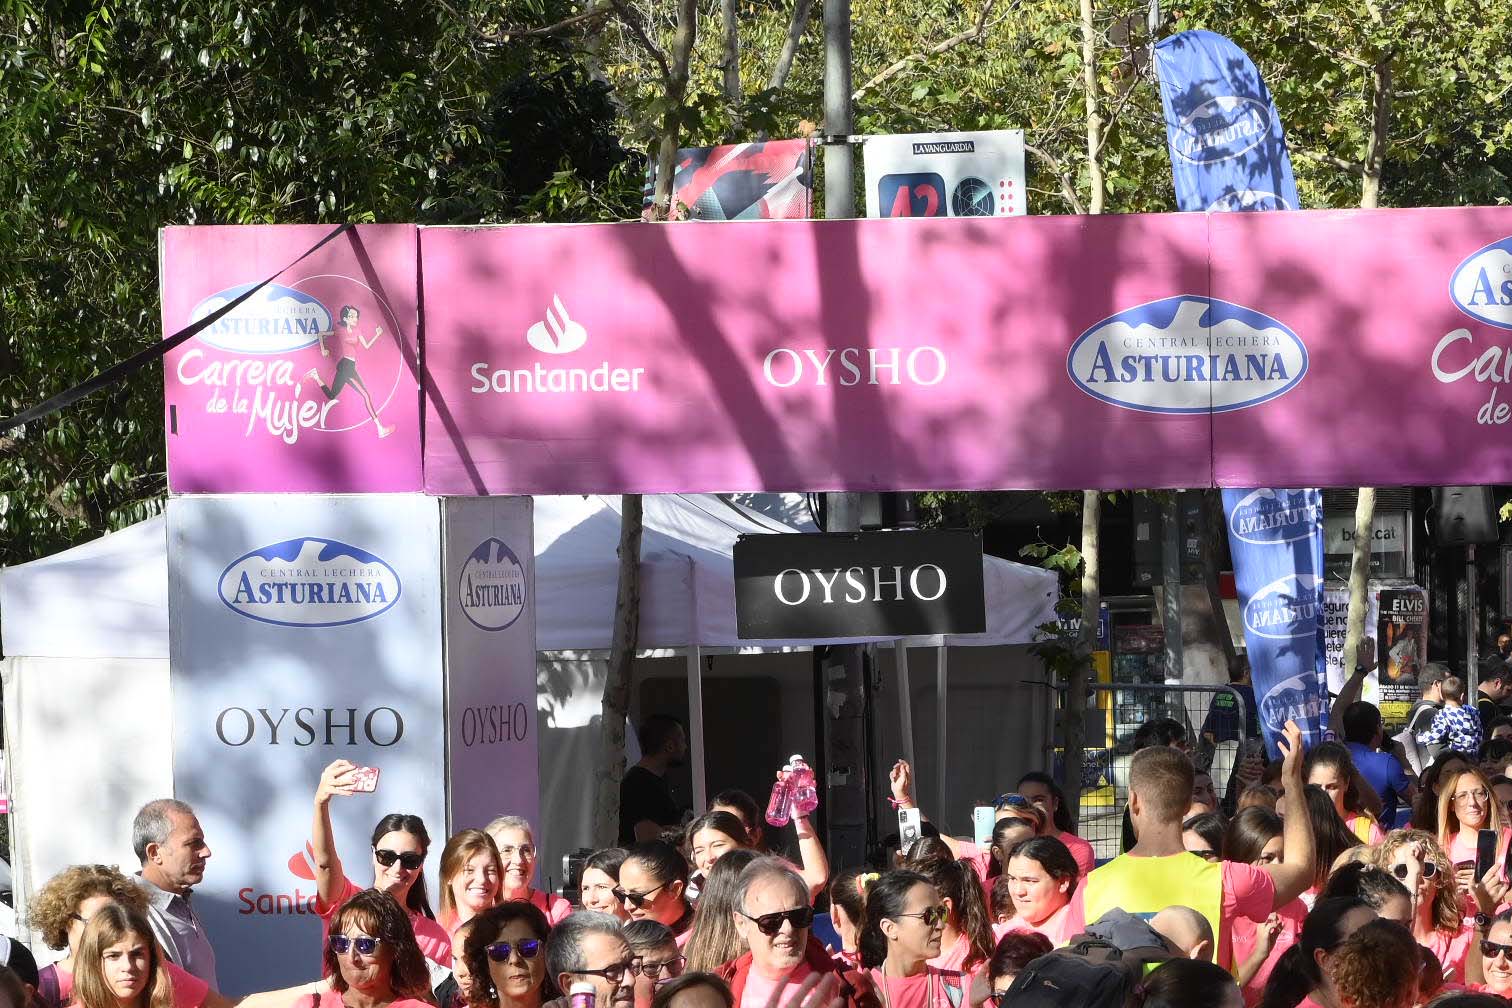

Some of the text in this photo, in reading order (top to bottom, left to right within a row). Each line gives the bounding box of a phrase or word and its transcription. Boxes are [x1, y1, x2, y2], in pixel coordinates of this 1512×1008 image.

[1123, 335, 1281, 349] CENTRAL LECHERA
[177, 349, 294, 386] Carrera
[471, 361, 644, 394] Santander
[763, 346, 948, 388] OYSHO
[1086, 340, 1290, 384] ASTURIANA
[207, 383, 340, 445] de la Mujer
[1477, 387, 1511, 425] de
[233, 570, 388, 605] ASTURIANA
[261, 568, 383, 578] CENTRAL LECHERA
[464, 573, 522, 608] ASTURIANA
[774, 563, 947, 606] OYSHO
[1392, 599, 1423, 612] ELVIS
[215, 706, 404, 747] OYSHO
[461, 702, 528, 748] OYSHO
